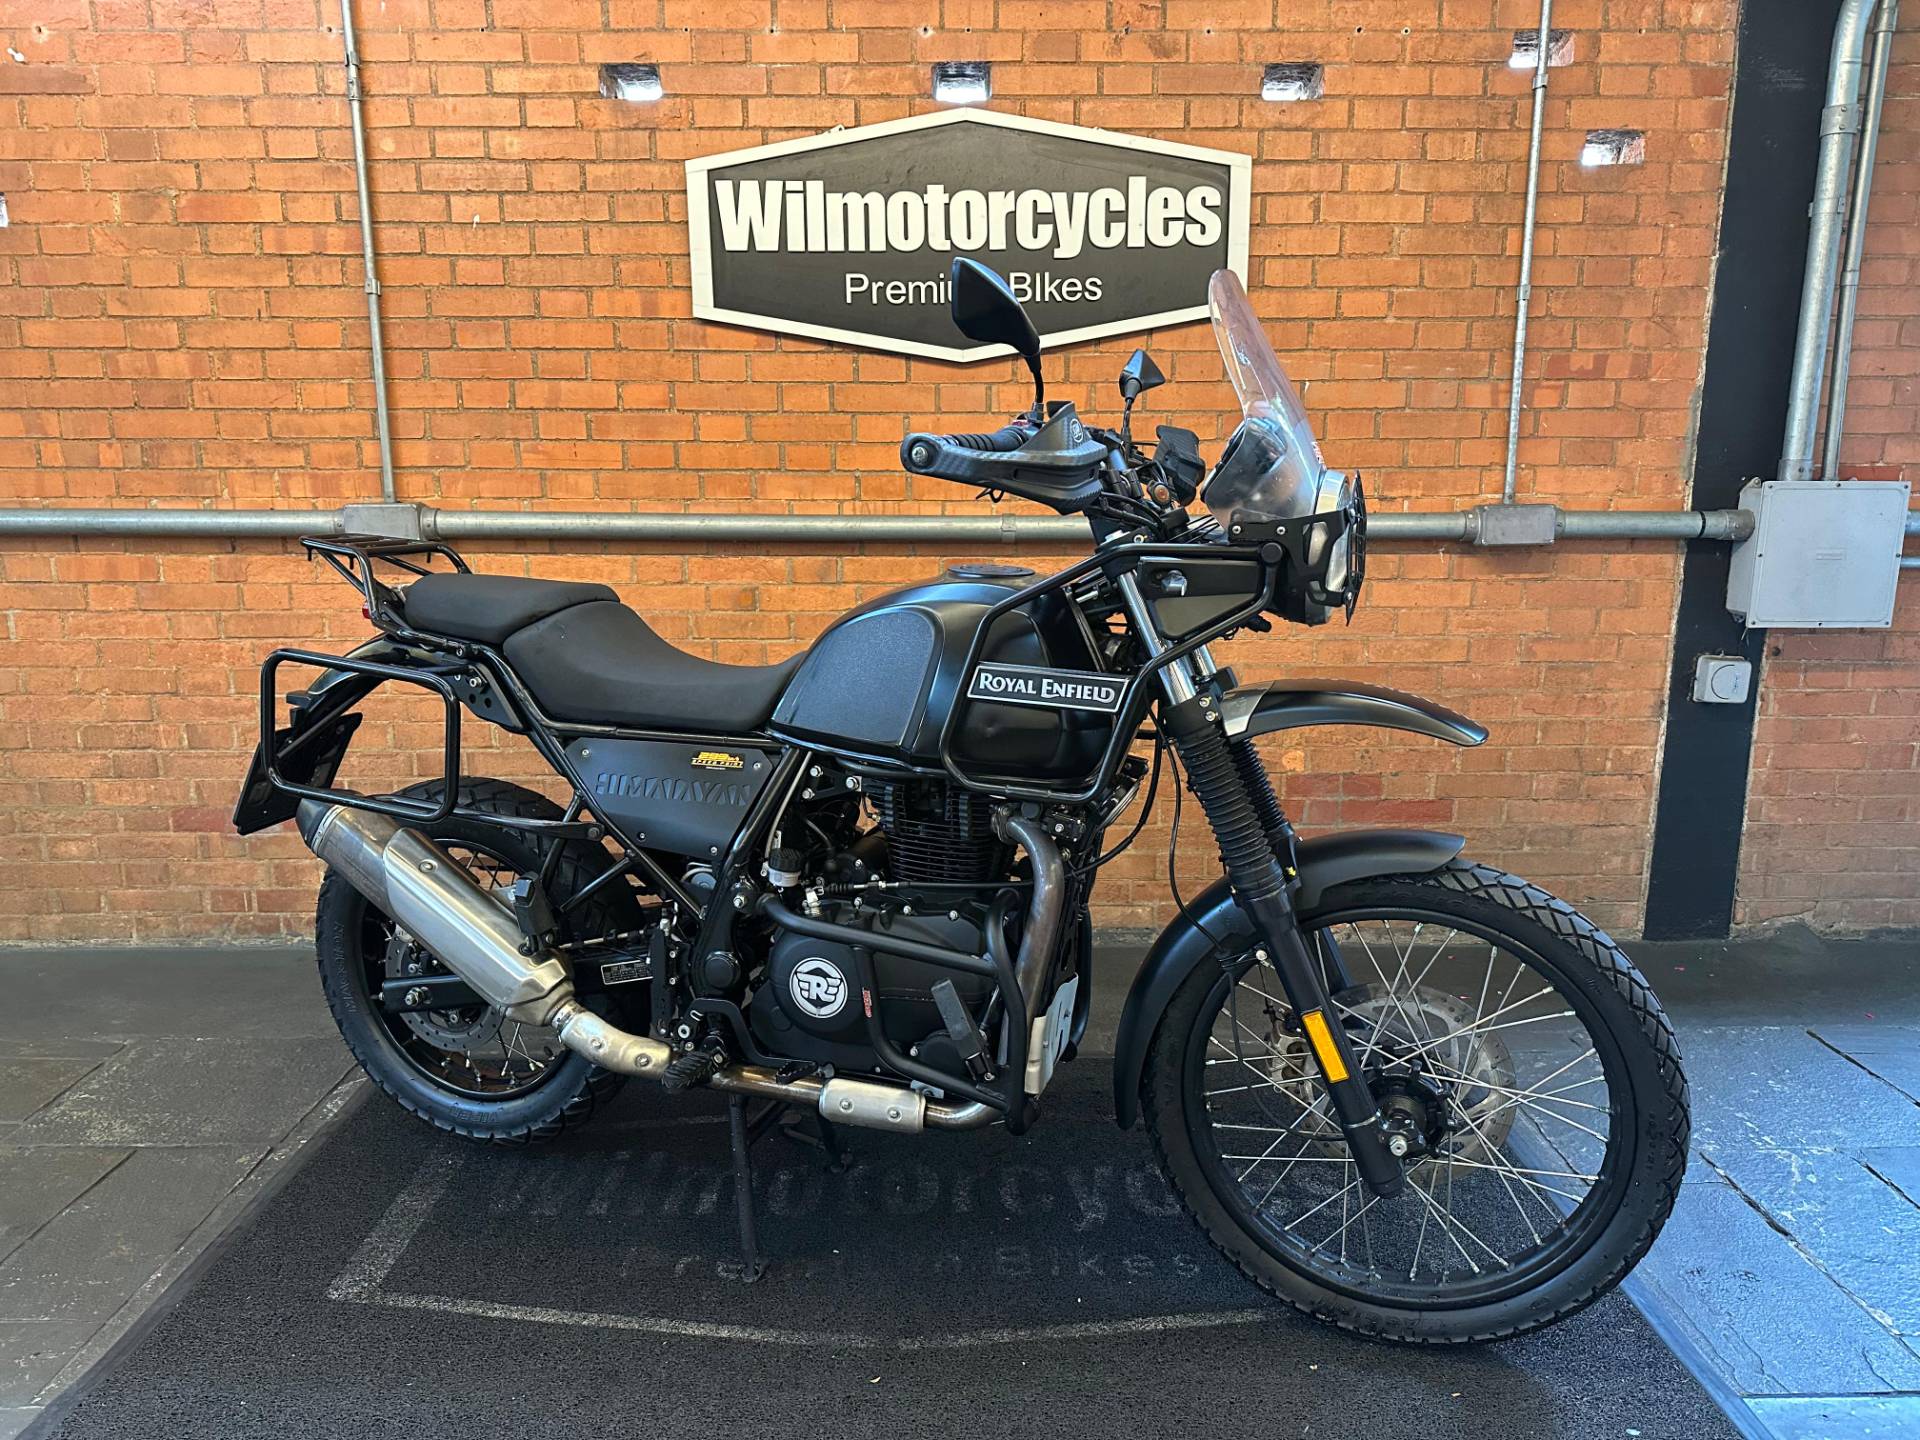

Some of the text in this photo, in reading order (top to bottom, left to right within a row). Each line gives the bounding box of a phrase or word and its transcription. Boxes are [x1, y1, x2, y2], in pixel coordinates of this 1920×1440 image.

[714, 176, 1222, 259] Wilmotorcycles
[845, 272, 953, 305] Premi
[978, 672, 1116, 704] ROYAL ENFIELD
